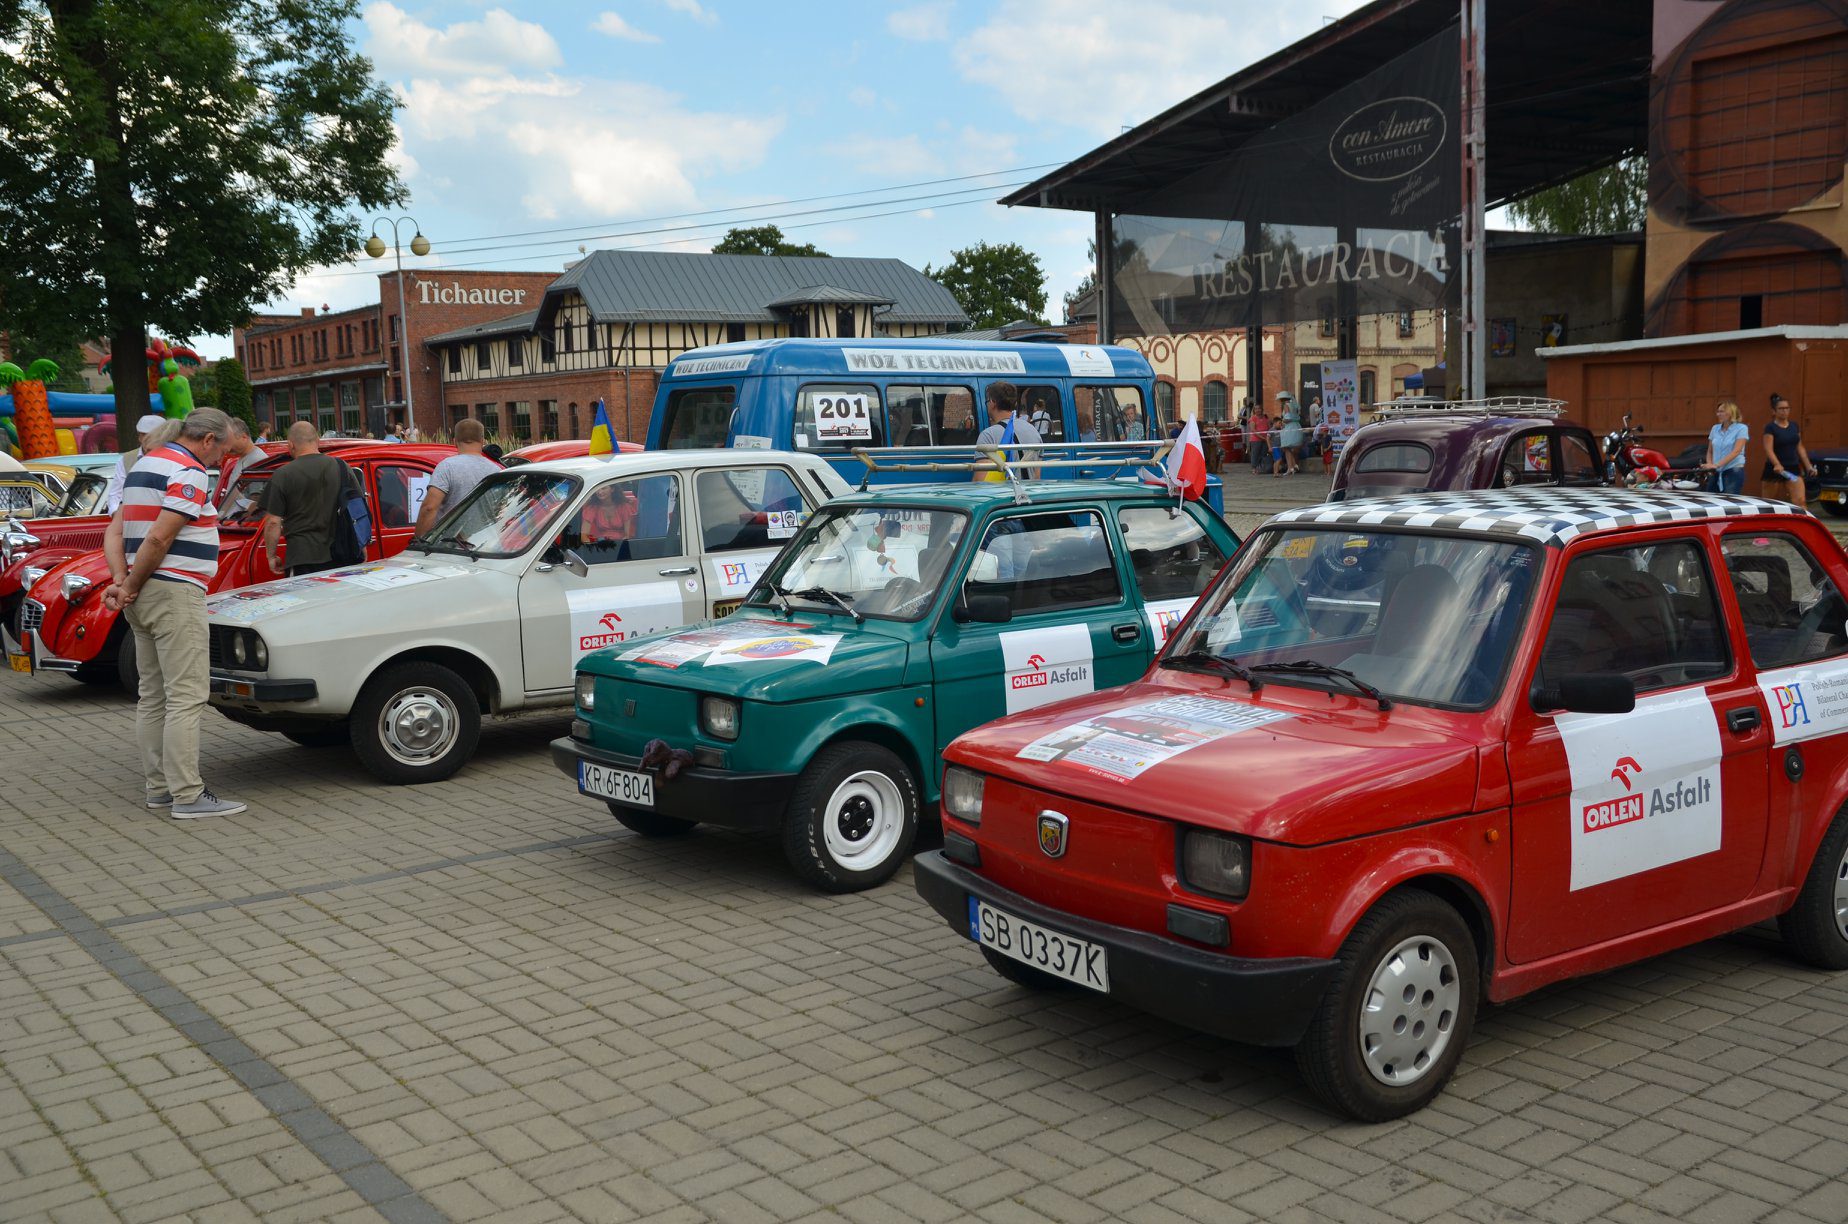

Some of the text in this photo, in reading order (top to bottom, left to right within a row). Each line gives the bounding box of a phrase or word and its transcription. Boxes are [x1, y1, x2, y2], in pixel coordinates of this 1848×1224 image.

[1342, 109, 1432, 149] con Amore
[1356, 144, 1423, 166] RESTAURACJA
[1200, 227, 1450, 300] RESTAURACJA
[416, 280, 526, 305] Tichauer
[695, 359, 746, 373] TECHNICZNY
[902, 354, 1018, 370] TECHNICZNY
[819, 397, 866, 418] 201
[582, 633, 622, 649] ORLEN
[1013, 666, 1087, 688] ORLEN Asfalt
[585, 764, 651, 803] KR 6F804
[1585, 776, 1711, 828] ORLEN Asfalt
[982, 907, 1103, 987] SB 0337K
